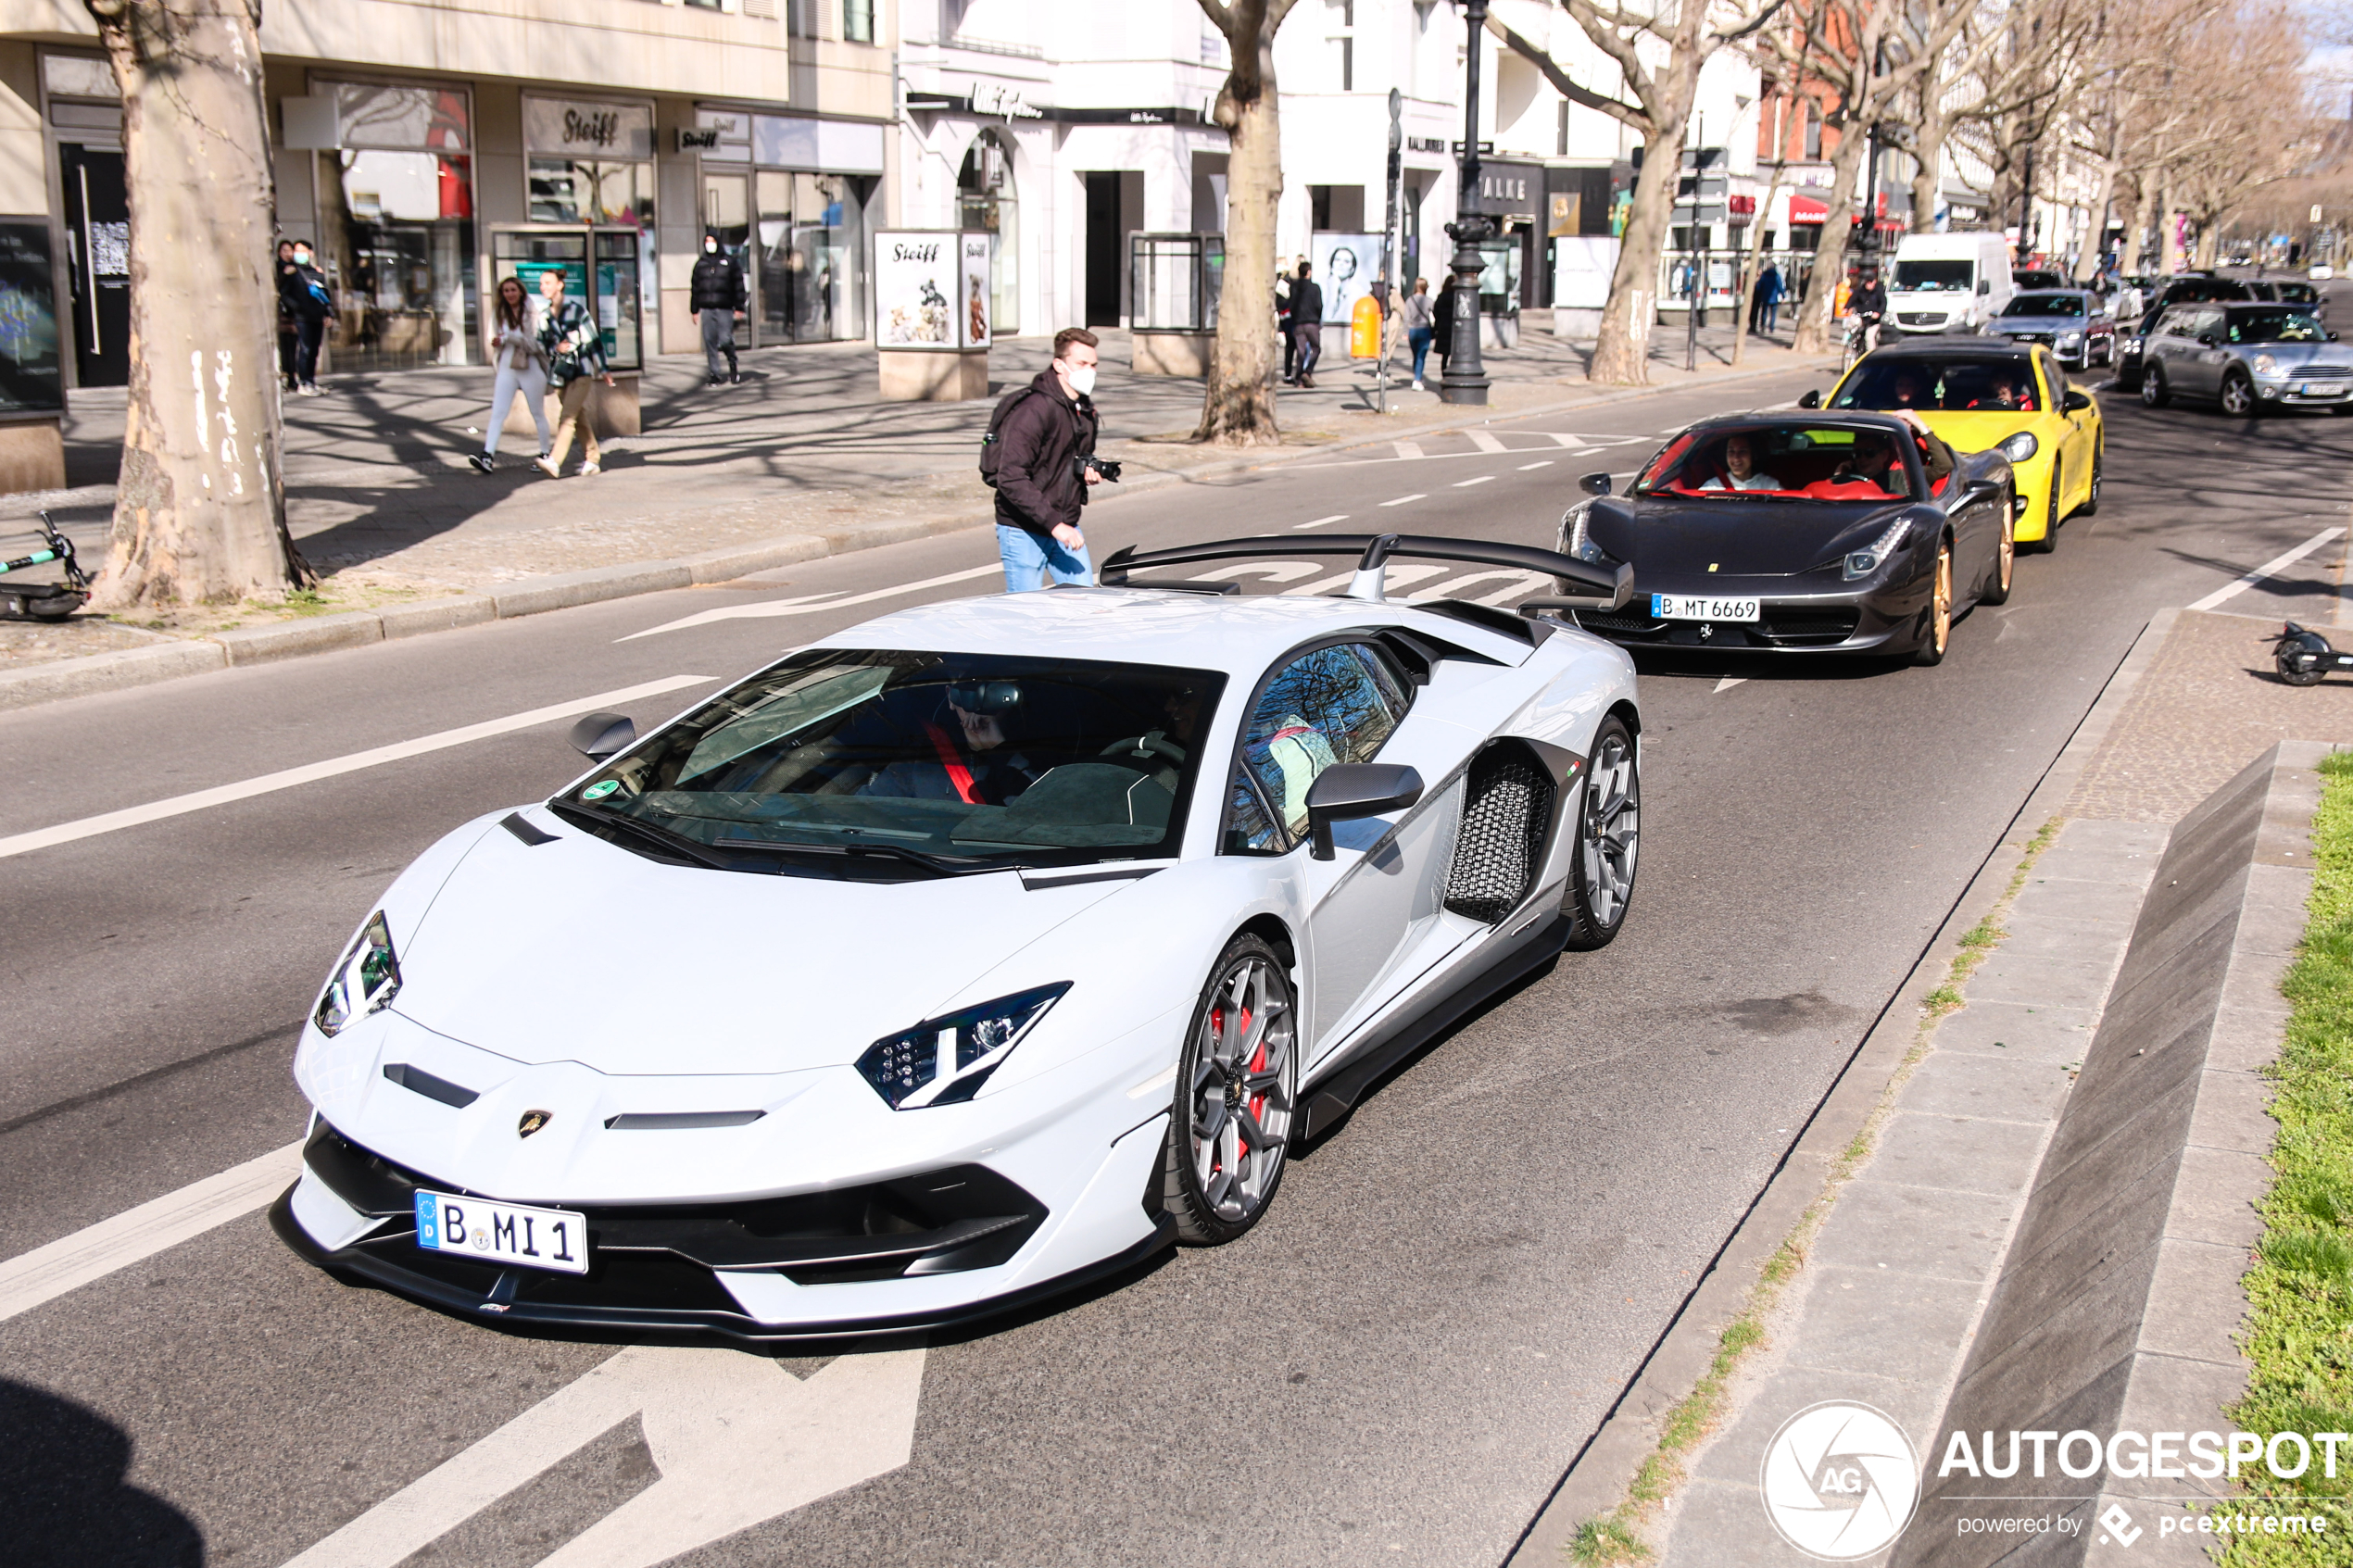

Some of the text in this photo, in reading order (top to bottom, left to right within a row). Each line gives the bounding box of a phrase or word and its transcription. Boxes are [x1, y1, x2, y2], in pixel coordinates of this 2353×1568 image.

[562, 108, 619, 146] Steiff
[682, 131, 717, 148] Steiff
[1478, 176, 1526, 201] ALKE
[893, 244, 939, 263] Steiff
[1663, 598, 1756, 618] B MT 6669
[424, 1224, 434, 1237] D
[444, 1204, 574, 1262] B MI 1
